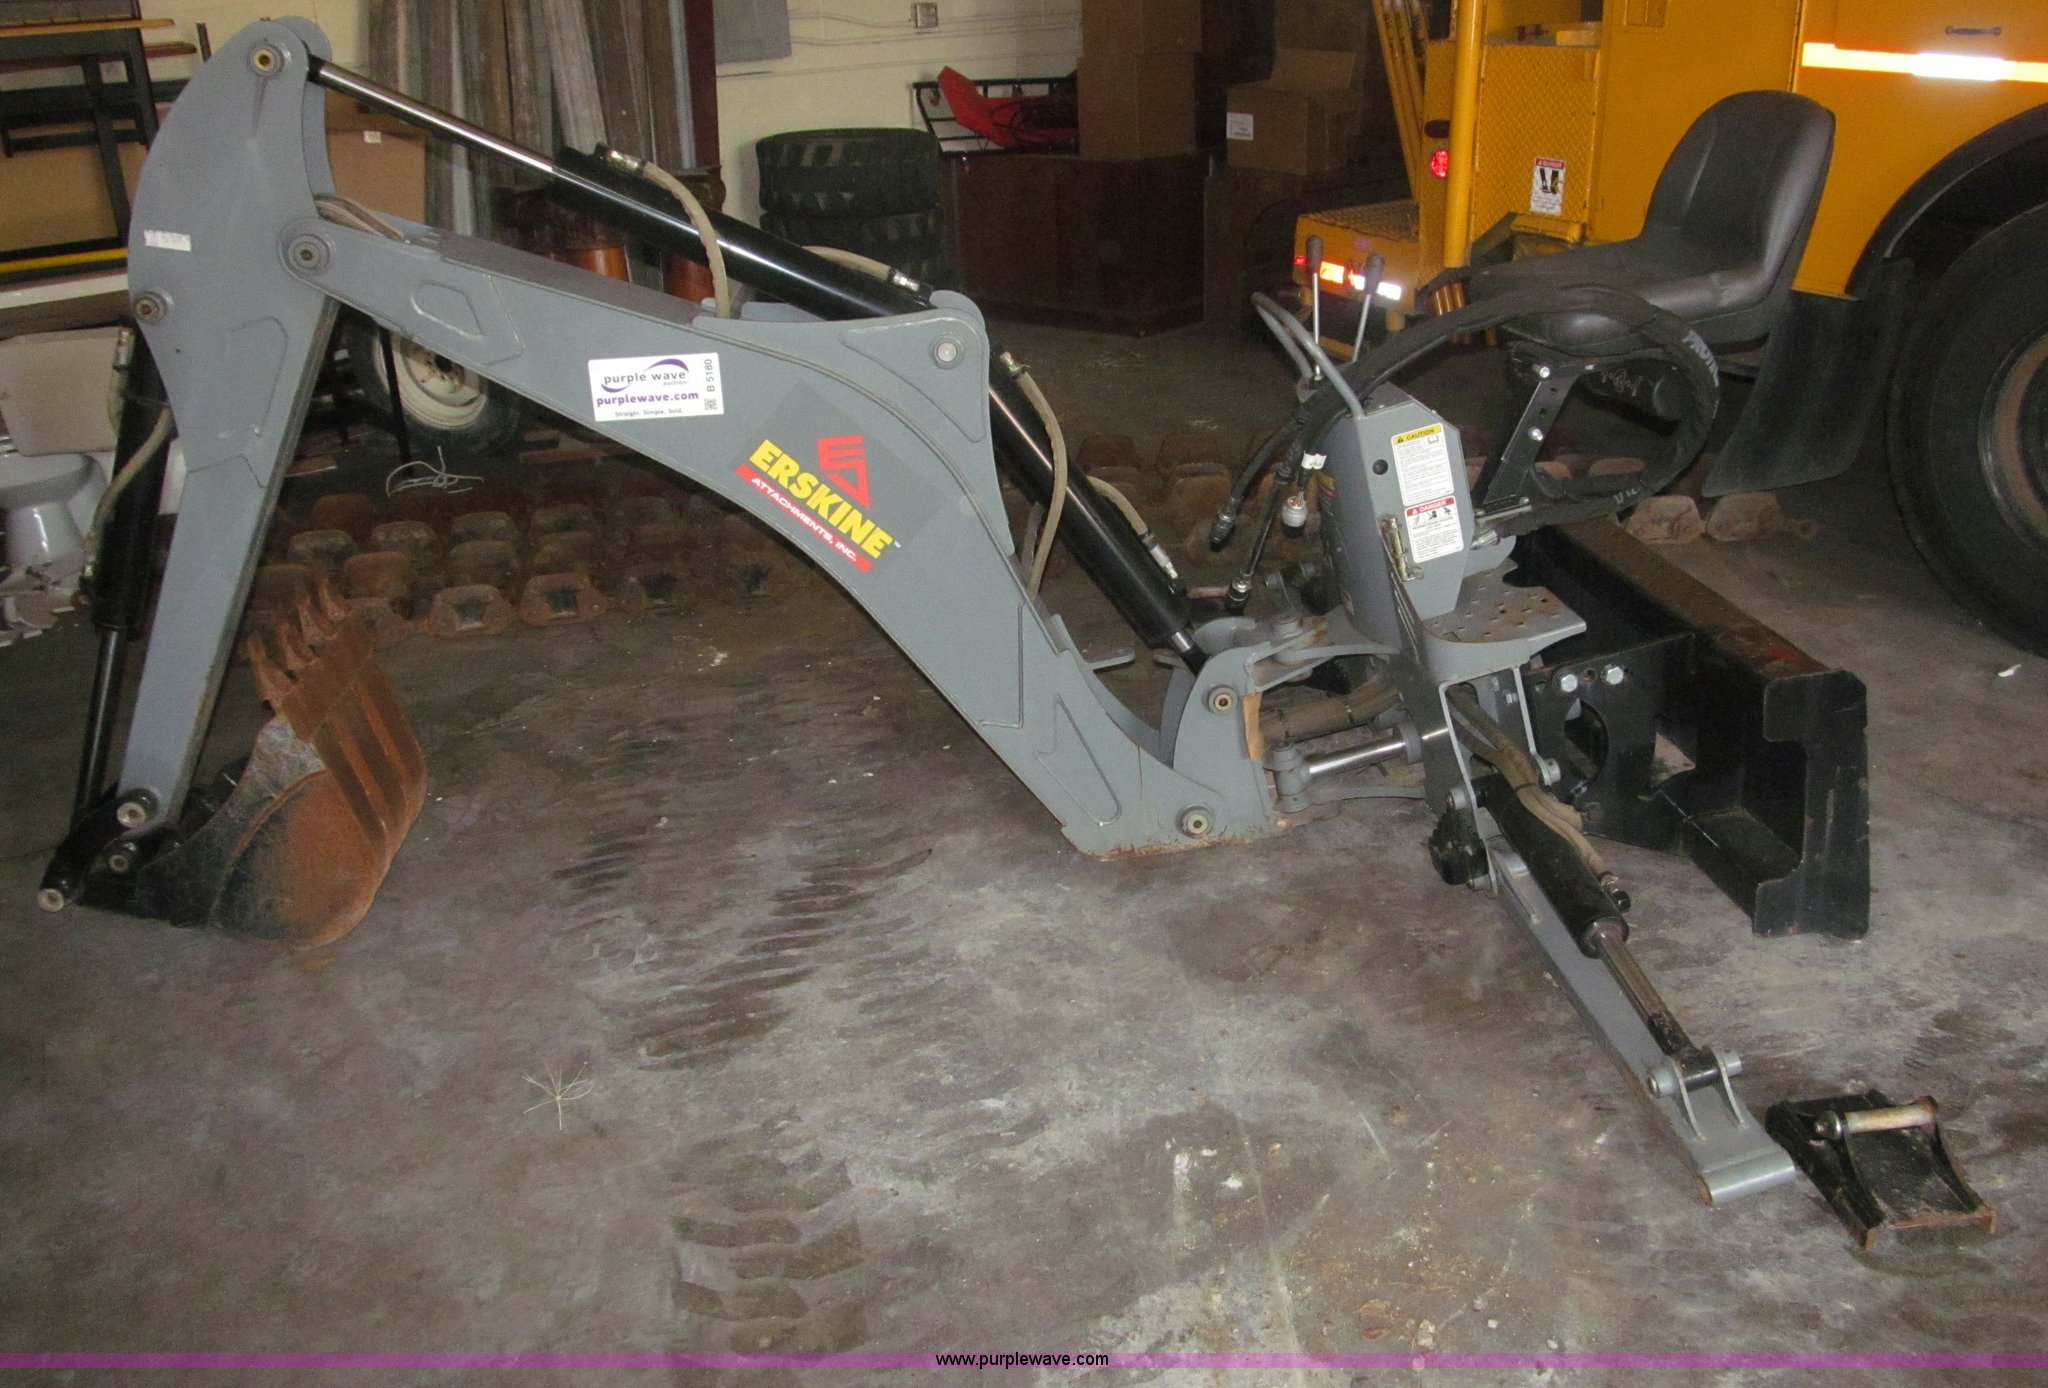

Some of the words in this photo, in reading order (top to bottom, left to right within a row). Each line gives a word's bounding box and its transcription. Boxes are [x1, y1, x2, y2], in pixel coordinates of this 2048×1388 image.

[704, 358, 715, 383] 5180
[604, 372, 647, 385] purple
[651, 371, 686, 382] wave
[597, 392, 699, 407] purplewave.com
[615, 410, 641, 418] Straight.
[643, 409, 665, 417] Simple.
[1406, 428, 1435, 440] CAUTION
[750, 439, 893, 559] ERSKINE
[1420, 500, 1447, 512] DANGER
[751, 477, 834, 544] ATTACHMENTS,
[835, 541, 857, 561] INC.
